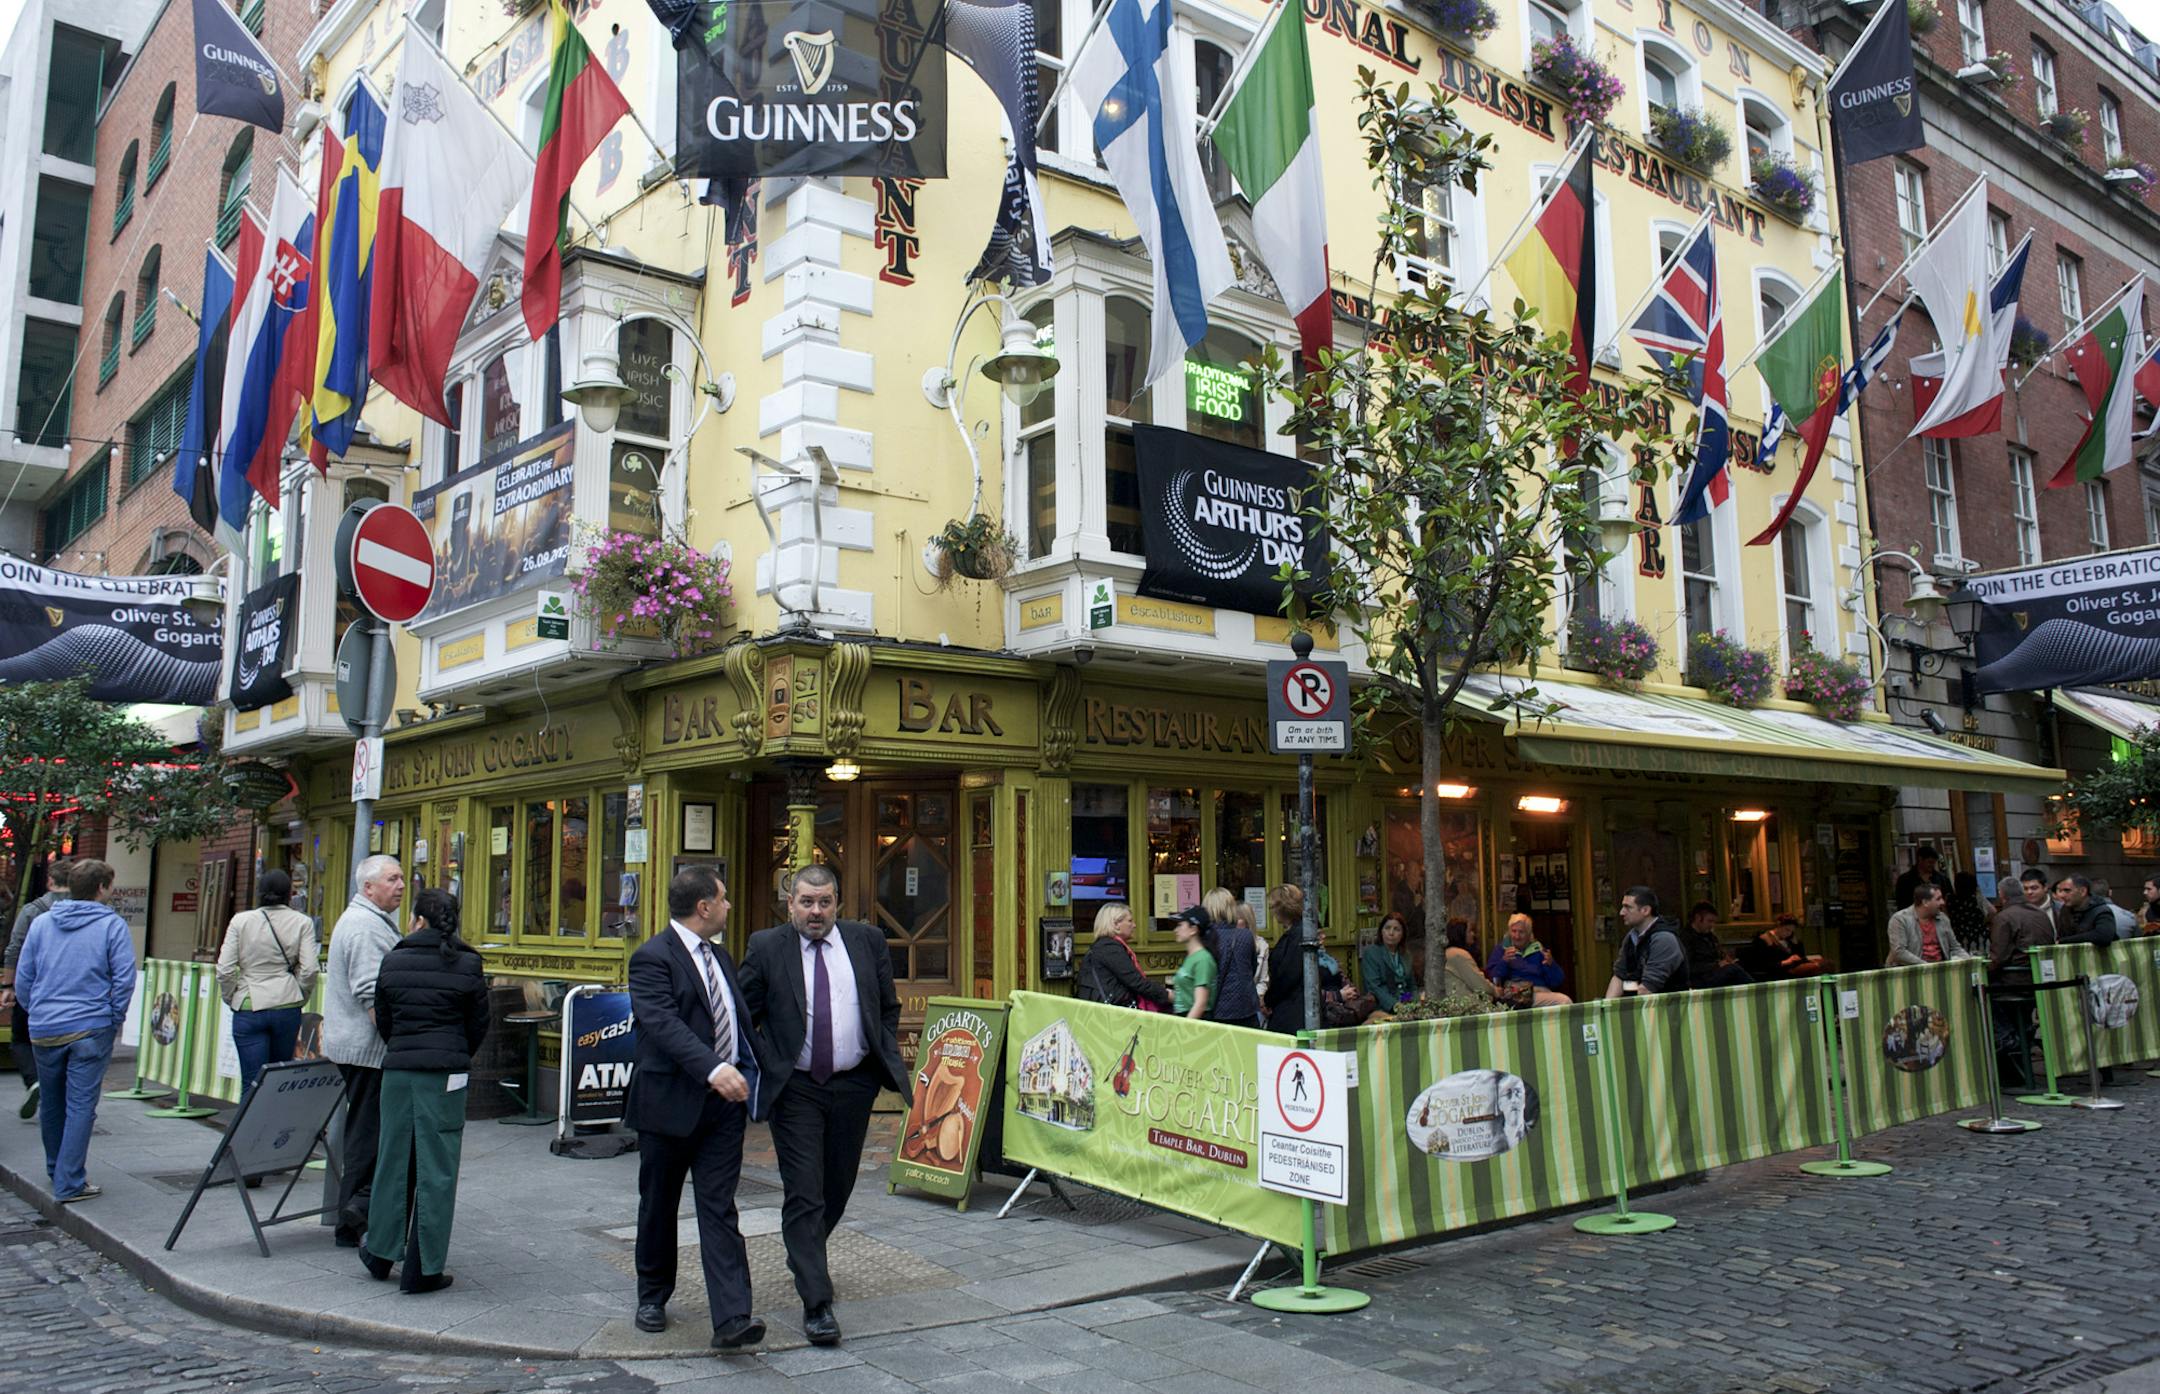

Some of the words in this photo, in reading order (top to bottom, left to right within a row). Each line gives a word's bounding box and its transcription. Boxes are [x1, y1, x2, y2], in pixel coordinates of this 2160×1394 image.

[827, 84, 849, 92] 1759
[1437, 47, 1556, 142] IRISH
[1839, 77, 1912, 109] GUINNESS
[706, 96, 917, 143] GUINNESS
[631, 352, 659, 368] LIVE
[626, 371, 660, 387] IRISH
[1184, 360, 1251, 391] TRADITIONAL
[636, 392, 664, 409] USIC
[1196, 377, 1240, 404] IRISH
[1195, 395, 1242, 422] FOOD
[494, 464, 575, 515] EXTRAORDINARY
[497, 461, 541, 492] CELEBRATE
[1203, 469, 1286, 510] GUINNESS
[1194, 495, 1304, 543] ARTHUR'S
[1262, 538, 1306, 570] DAY
[2009, 573, 2045, 593] THE
[2066, 597, 2118, 613] Oliver
[2122, 590, 2146, 606] St.
[111, 608, 168, 625] Oliver
[172, 611, 197, 627] St.
[796, 667, 819, 692] 57
[662, 693, 724, 746] BAR
[898, 676, 1003, 736] BAR
[1085, 696, 1270, 756] RESTAURAN
[1284, 735, 1295, 744] AT
[1297, 735, 1316, 744] ANY
[1318, 735, 1339, 744] TIME
[1316, 726, 1334, 734] bith
[436, 742, 476, 786] JOHN
[483, 720, 577, 773] GOGARTY
[112, 887, 147, 898] ANGER
[927, 1011, 993, 1050] GOGARTY'S
[1146, 1054, 1205, 1090] OLIVER
[1211, 1067, 1232, 1096] ST
[1284, 1102, 1316, 1115] PEDESTRIANS
[1457, 1124, 1485, 1137] DUBLIN
[1152, 1129, 1184, 1150] TEMPLE
[1208, 1144, 1245, 1166] DUBLIN
[1271, 1138, 1299, 1152] Ceantar
[1300, 1142, 1333, 1159] Coisithe
[1268, 1152, 1336, 1175] PEDESTRIANISED
[1288, 1171, 1312, 1186] ZONE
